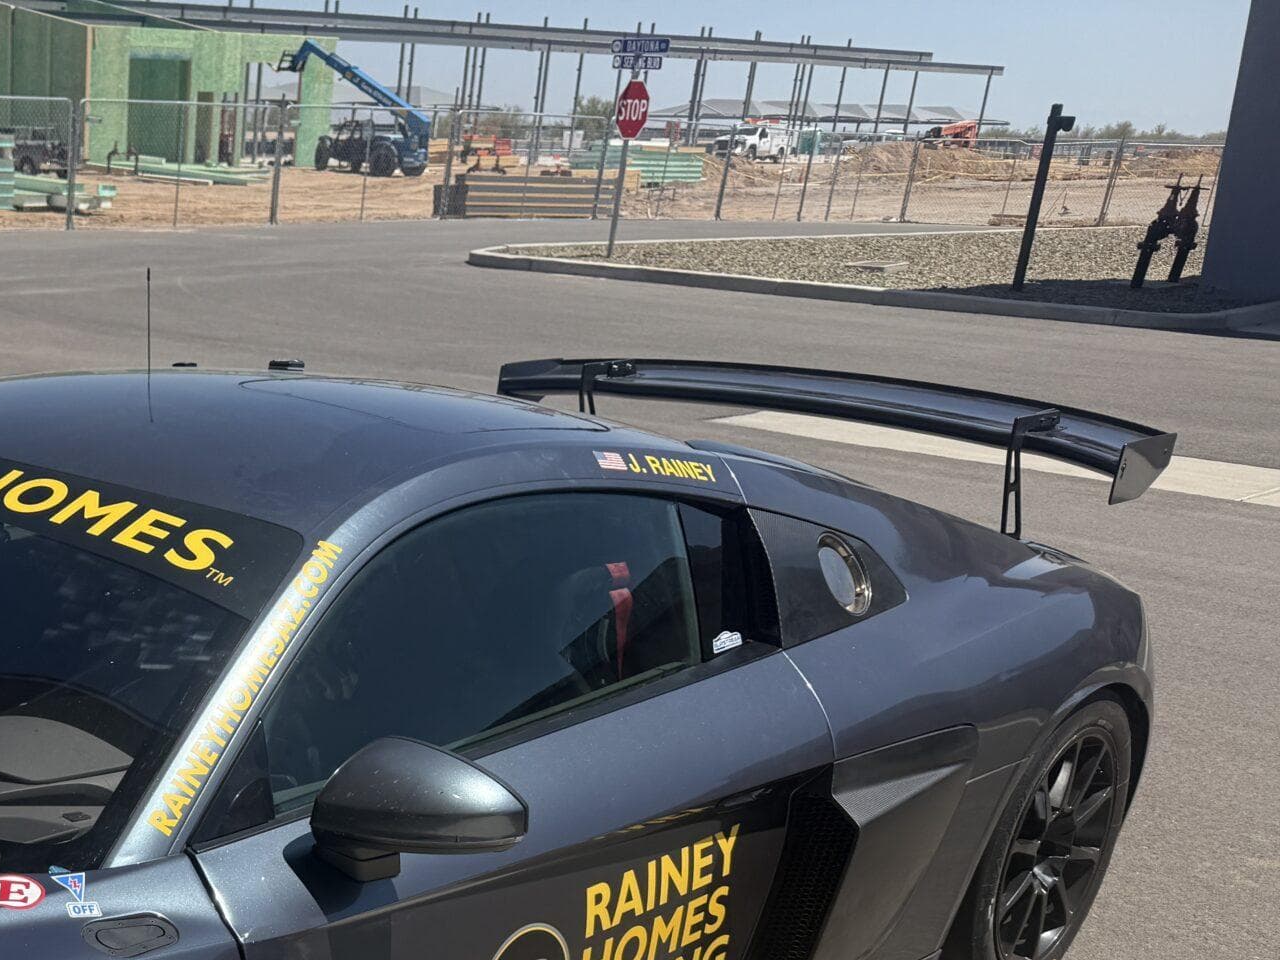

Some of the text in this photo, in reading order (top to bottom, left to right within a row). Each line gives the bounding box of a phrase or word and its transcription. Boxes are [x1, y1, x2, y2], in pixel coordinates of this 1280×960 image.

[626, 40, 660, 52] DAYTONA
[646, 57, 660, 69] BLVD
[619, 99, 648, 121] STOP
[628, 453, 716, 482] J. RAINEY
[146, 540, 343, 837] RAINEYHOMESAZ.COM
[585, 823, 741, 939] RAINEY
[72, 904, 96, 915] OFF
